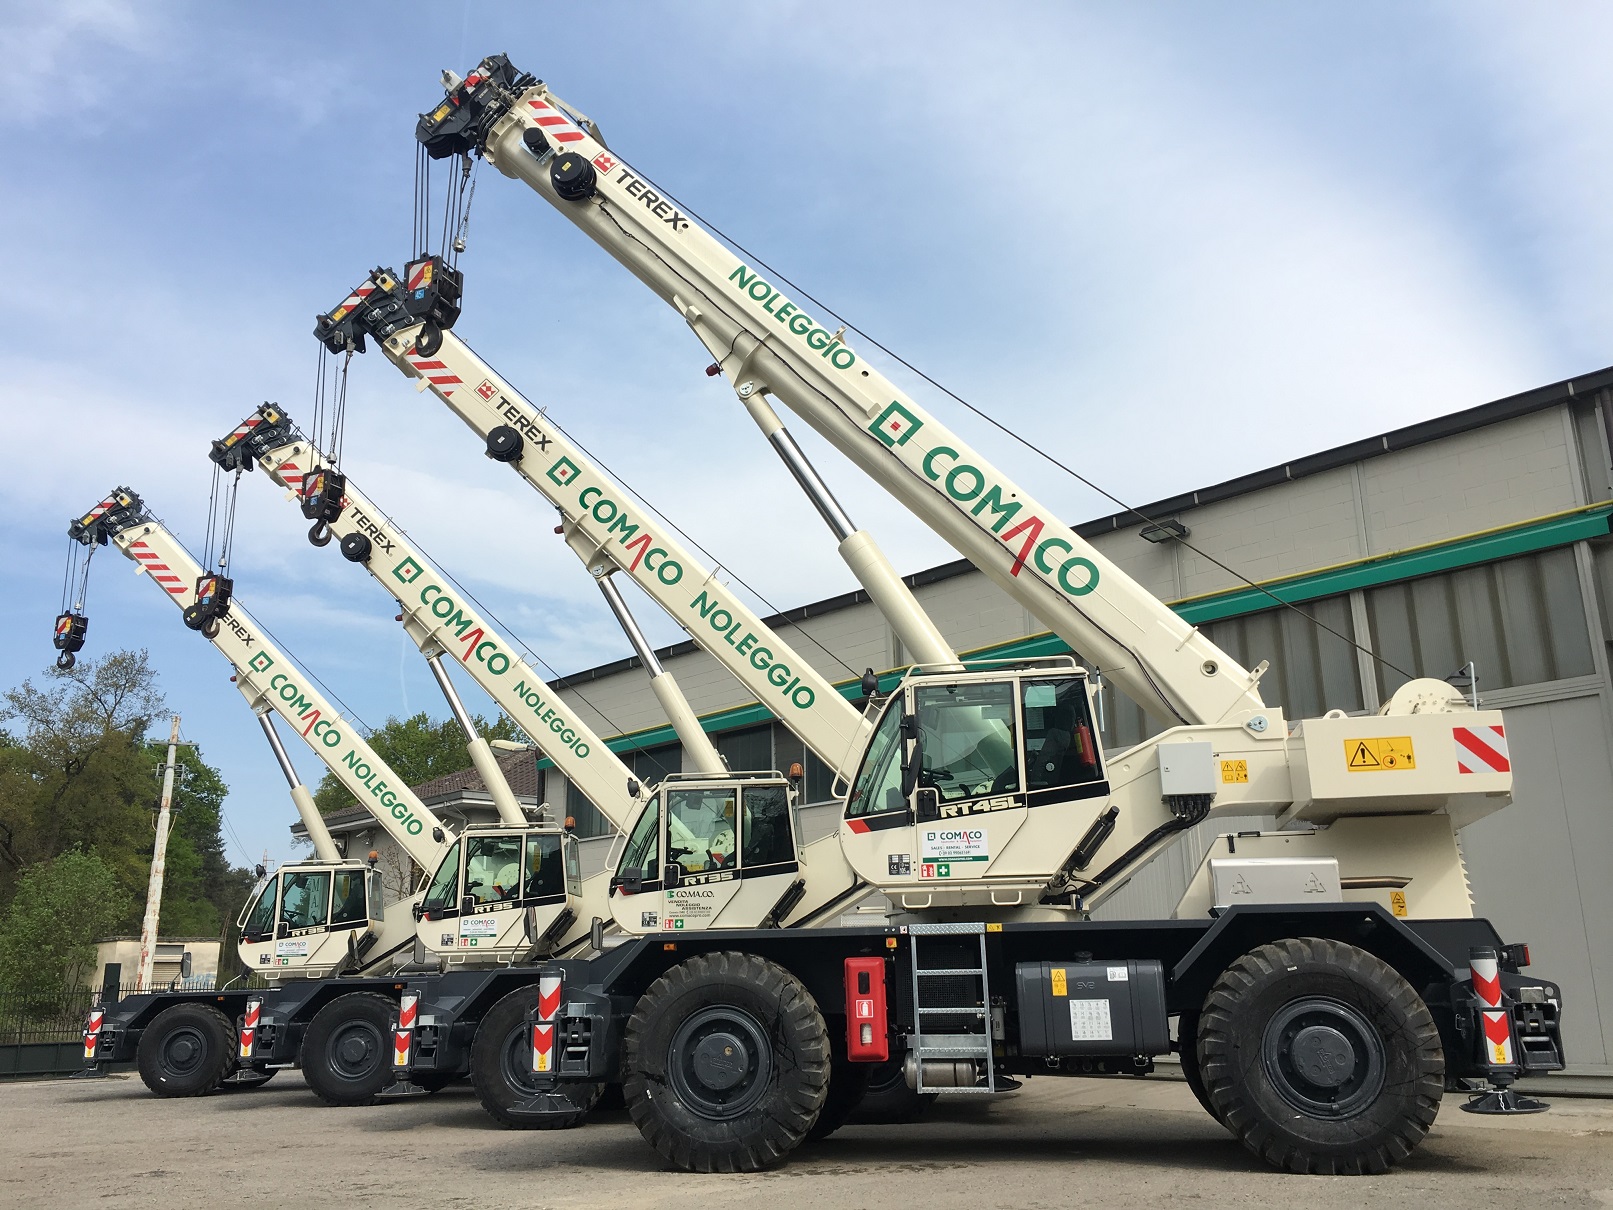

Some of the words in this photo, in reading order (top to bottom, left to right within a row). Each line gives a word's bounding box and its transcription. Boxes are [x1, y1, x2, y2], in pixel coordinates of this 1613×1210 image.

[616, 168, 686, 231] TEREX
[728, 265, 856, 369] NOLEGGIO
[495, 396, 553, 452] TEREX
[350, 506, 396, 555] TEREX
[922, 446, 1100, 596] COMACO
[222, 611, 255, 647] EREX
[578, 487, 684, 585] COMACO
[689, 590, 815, 709] NOLEGGIO
[420, 585, 510, 675] COMACO
[513, 680, 590, 759] NOLEGGIO
[270, 674, 341, 747] COMACO
[342, 750, 423, 835] NOLEGGIO
[940, 831, 982, 844] COMACO
